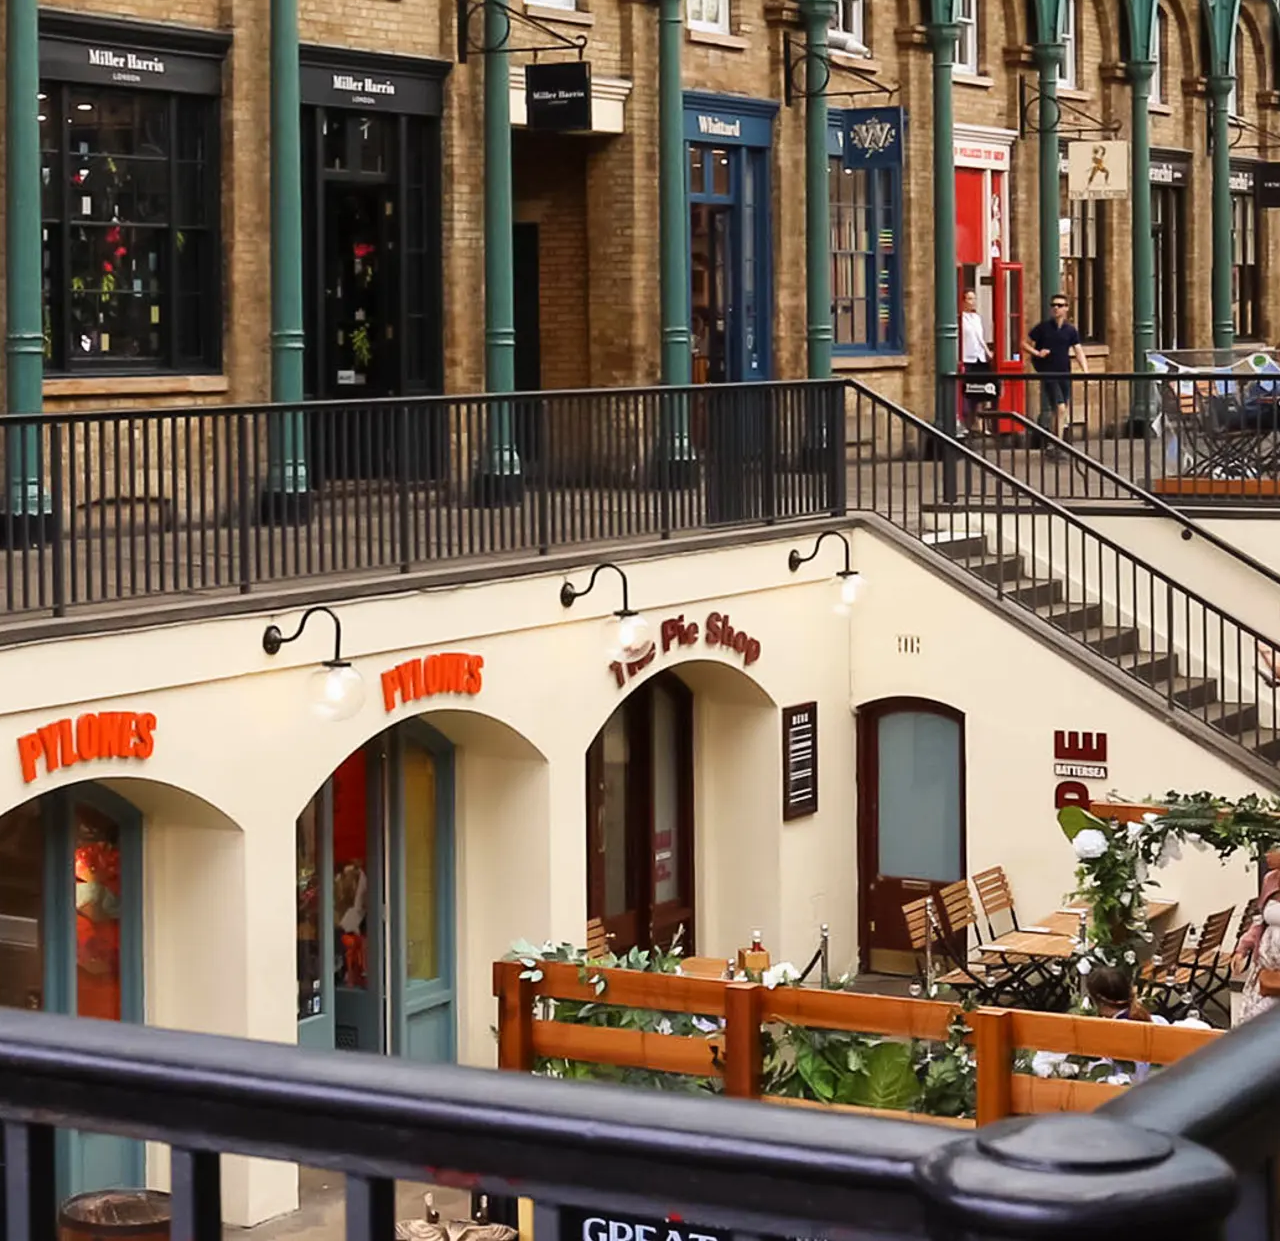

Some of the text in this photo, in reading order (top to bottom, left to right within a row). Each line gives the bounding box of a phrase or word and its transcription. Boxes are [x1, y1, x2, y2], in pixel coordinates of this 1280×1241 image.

[88, 49, 165, 73] Miller Harris
[332, 74, 395, 95] Miller Harris
[697, 114, 741, 137] Whittard
[661, 614, 700, 655] Pie
[706, 612, 762, 667] Shop
[381, 652, 484, 713] PYLONES
[16, 710, 158, 784] PYLONES
